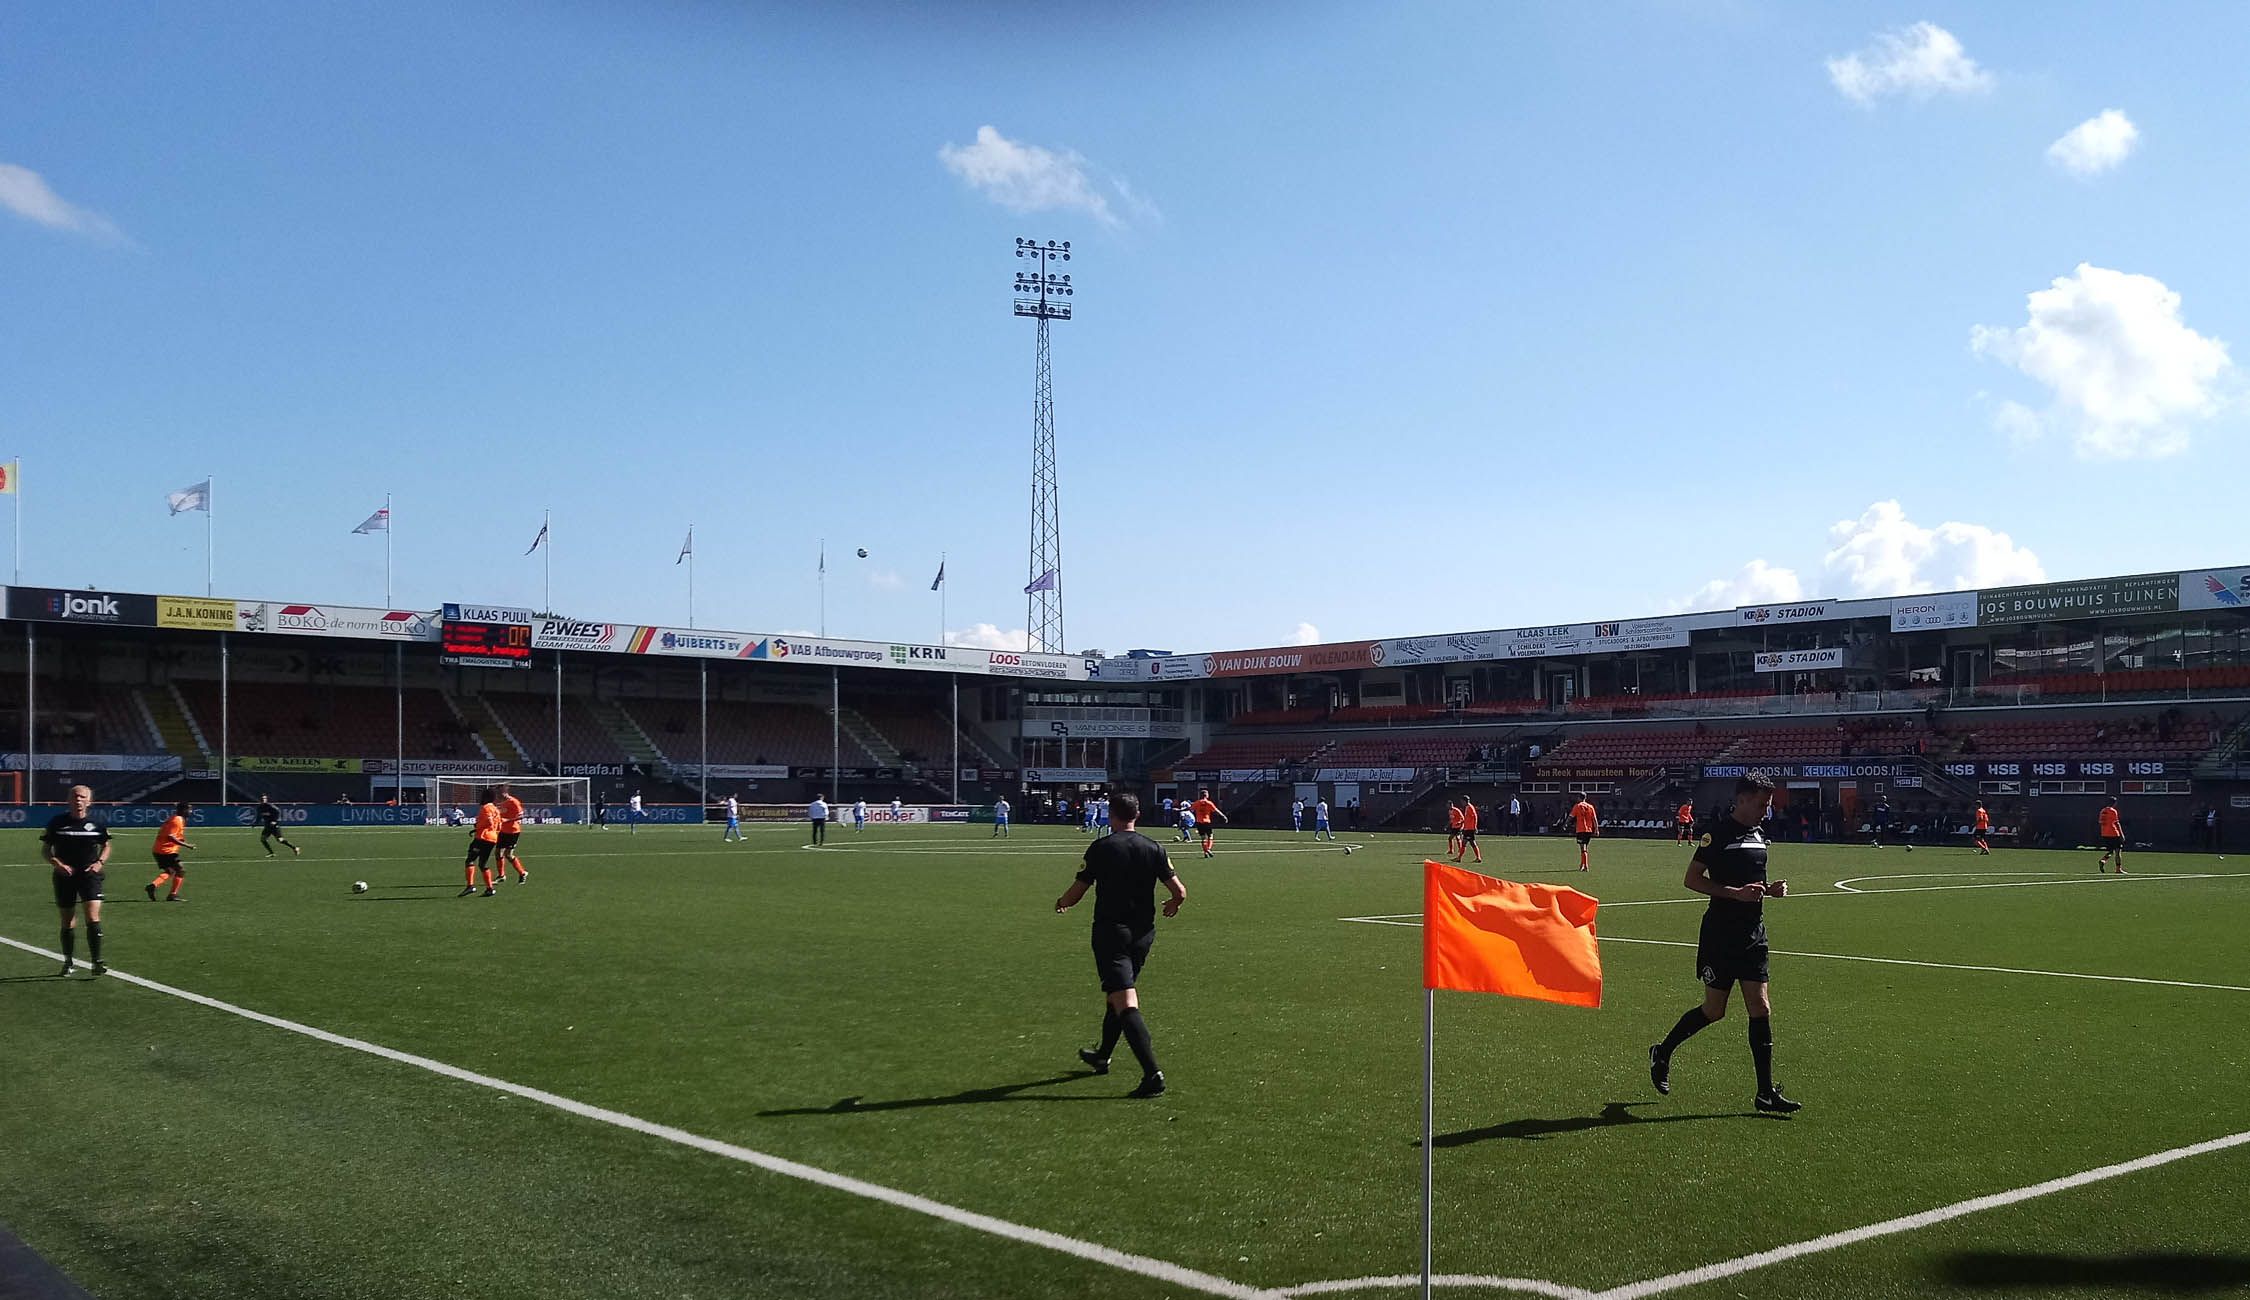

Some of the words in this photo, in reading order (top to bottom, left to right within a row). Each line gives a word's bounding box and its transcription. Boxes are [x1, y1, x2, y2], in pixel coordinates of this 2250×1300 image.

[62, 593, 119, 617] jonk
[1979, 601, 2006, 616] JOS
[2014, 594, 2103, 611] BOUWHUIS
[2112, 588, 2178, 603] TUINEN
[464, 608, 498, 621] KLAAS
[502, 611, 529, 623] PUUL
[1777, 606, 1825, 618] STADION
[1897, 605, 1936, 614] HERON
[346, 621, 378, 631] norm
[380, 621, 426, 633] BOKO
[1517, 629, 1544, 638] KLAAS
[1547, 627, 1569, 636] LEEK
[1595, 623, 1620, 637] DSW
[565, 642, 611, 651] HOLLAND
[677, 637, 726, 650] UIBERTS
[790, 644, 811, 656] VAB
[815, 645, 883, 662] Afbouwgroep
[909, 647, 946, 659] KRN
[989, 652, 1020, 665] LOOS
[1788, 651, 1836, 663] STADION
[1219, 658, 1242, 671] VAN
[1243, 656, 1267, 670] DIJK
[1269, 654, 1302, 668] BOUW
[1308, 650, 1367, 665] VOLENDAM
[382, 762, 425, 772] PLSTIC
[430, 763, 507, 772] VERPAKKINGEN
[563, 763, 624, 776] metafa.nl
[1536, 768, 1551, 777] Jan
[1576, 768, 1624, 777] natuursteen
[1988, 763, 2020, 776] HSB
[2033, 763, 2066, 776] HSB
[2080, 763, 2115, 775] HSB
[2128, 762, 2164, 775] HSB
[132, 808, 205, 823] SPOS
[341, 808, 395, 822] LIVING
[864, 810, 915, 821] eldboer
